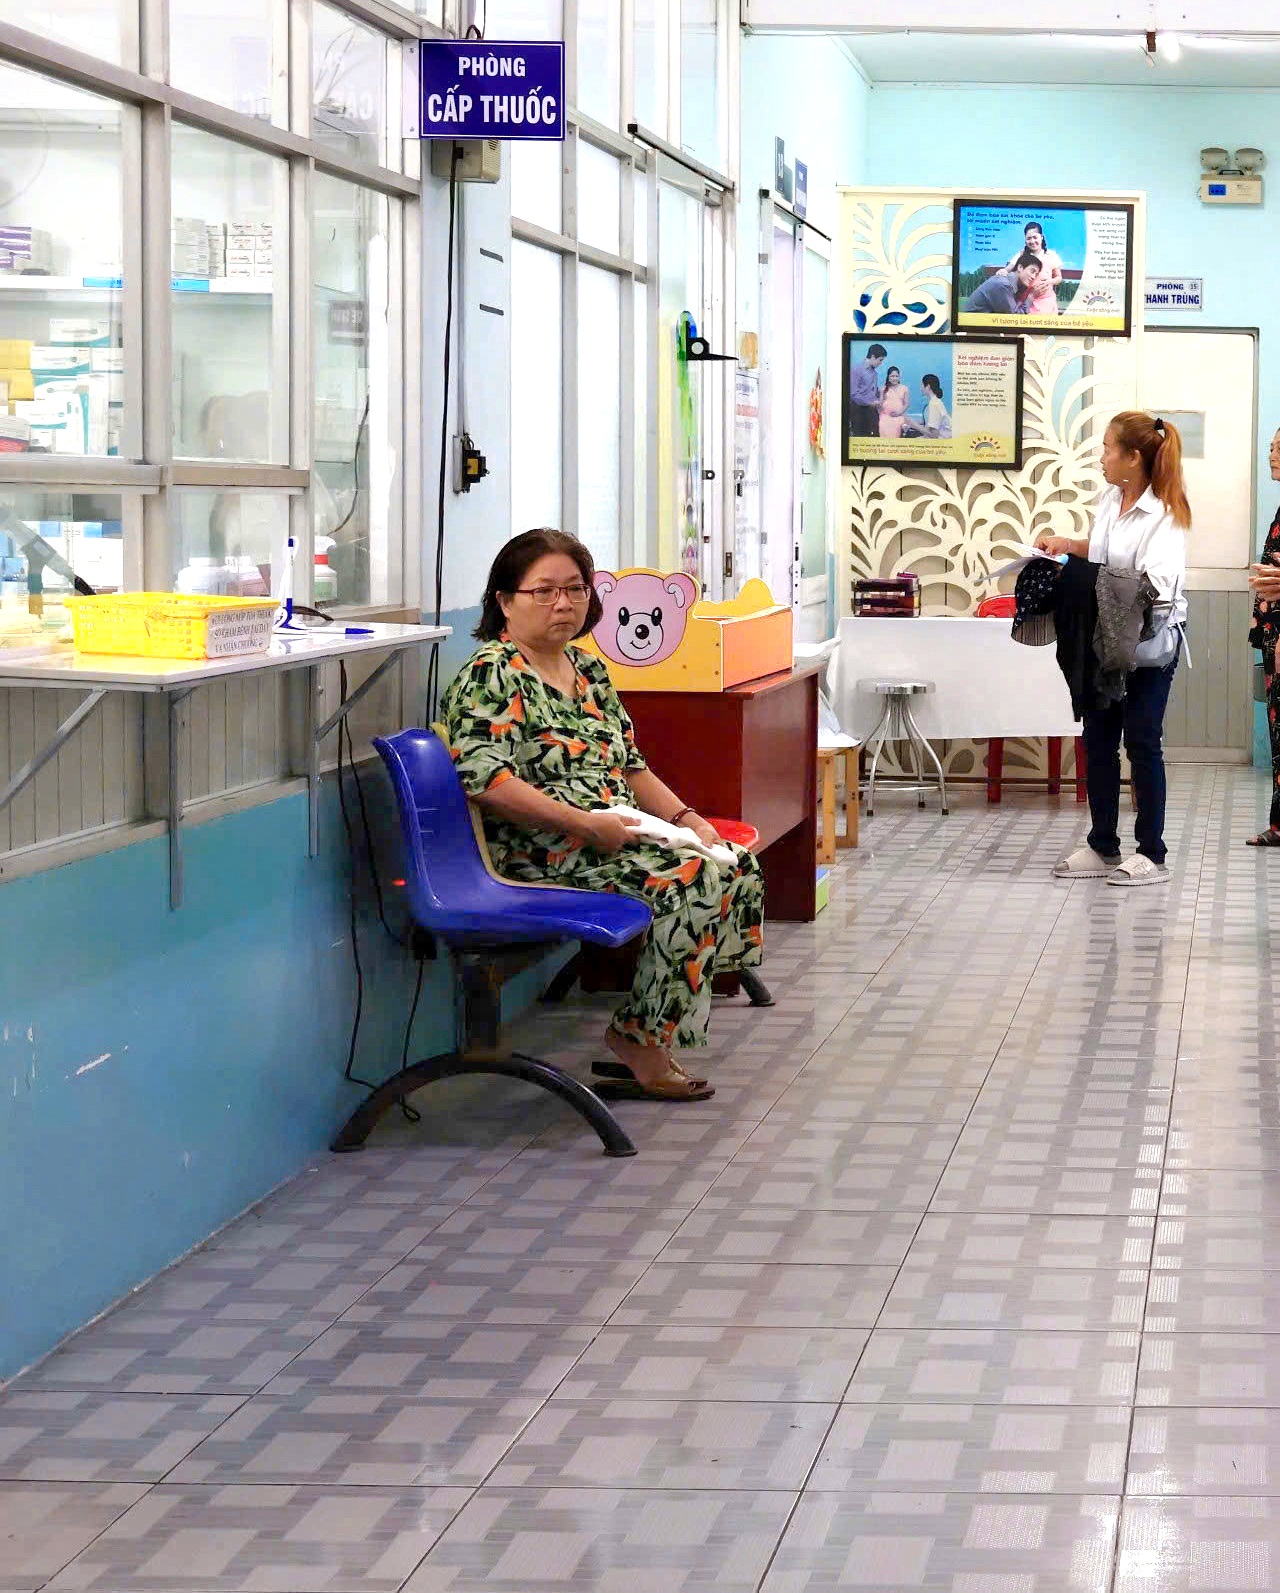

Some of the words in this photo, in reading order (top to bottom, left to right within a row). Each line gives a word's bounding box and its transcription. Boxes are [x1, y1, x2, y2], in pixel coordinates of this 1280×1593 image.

[458, 52, 526, 77] PHÒNG
[427, 84, 473, 123] CẤP
[480, 85, 557, 124] THUỐC
[1156, 282, 1184, 290] PHÒNG
[1171, 292, 1200, 305] TRÙNG
